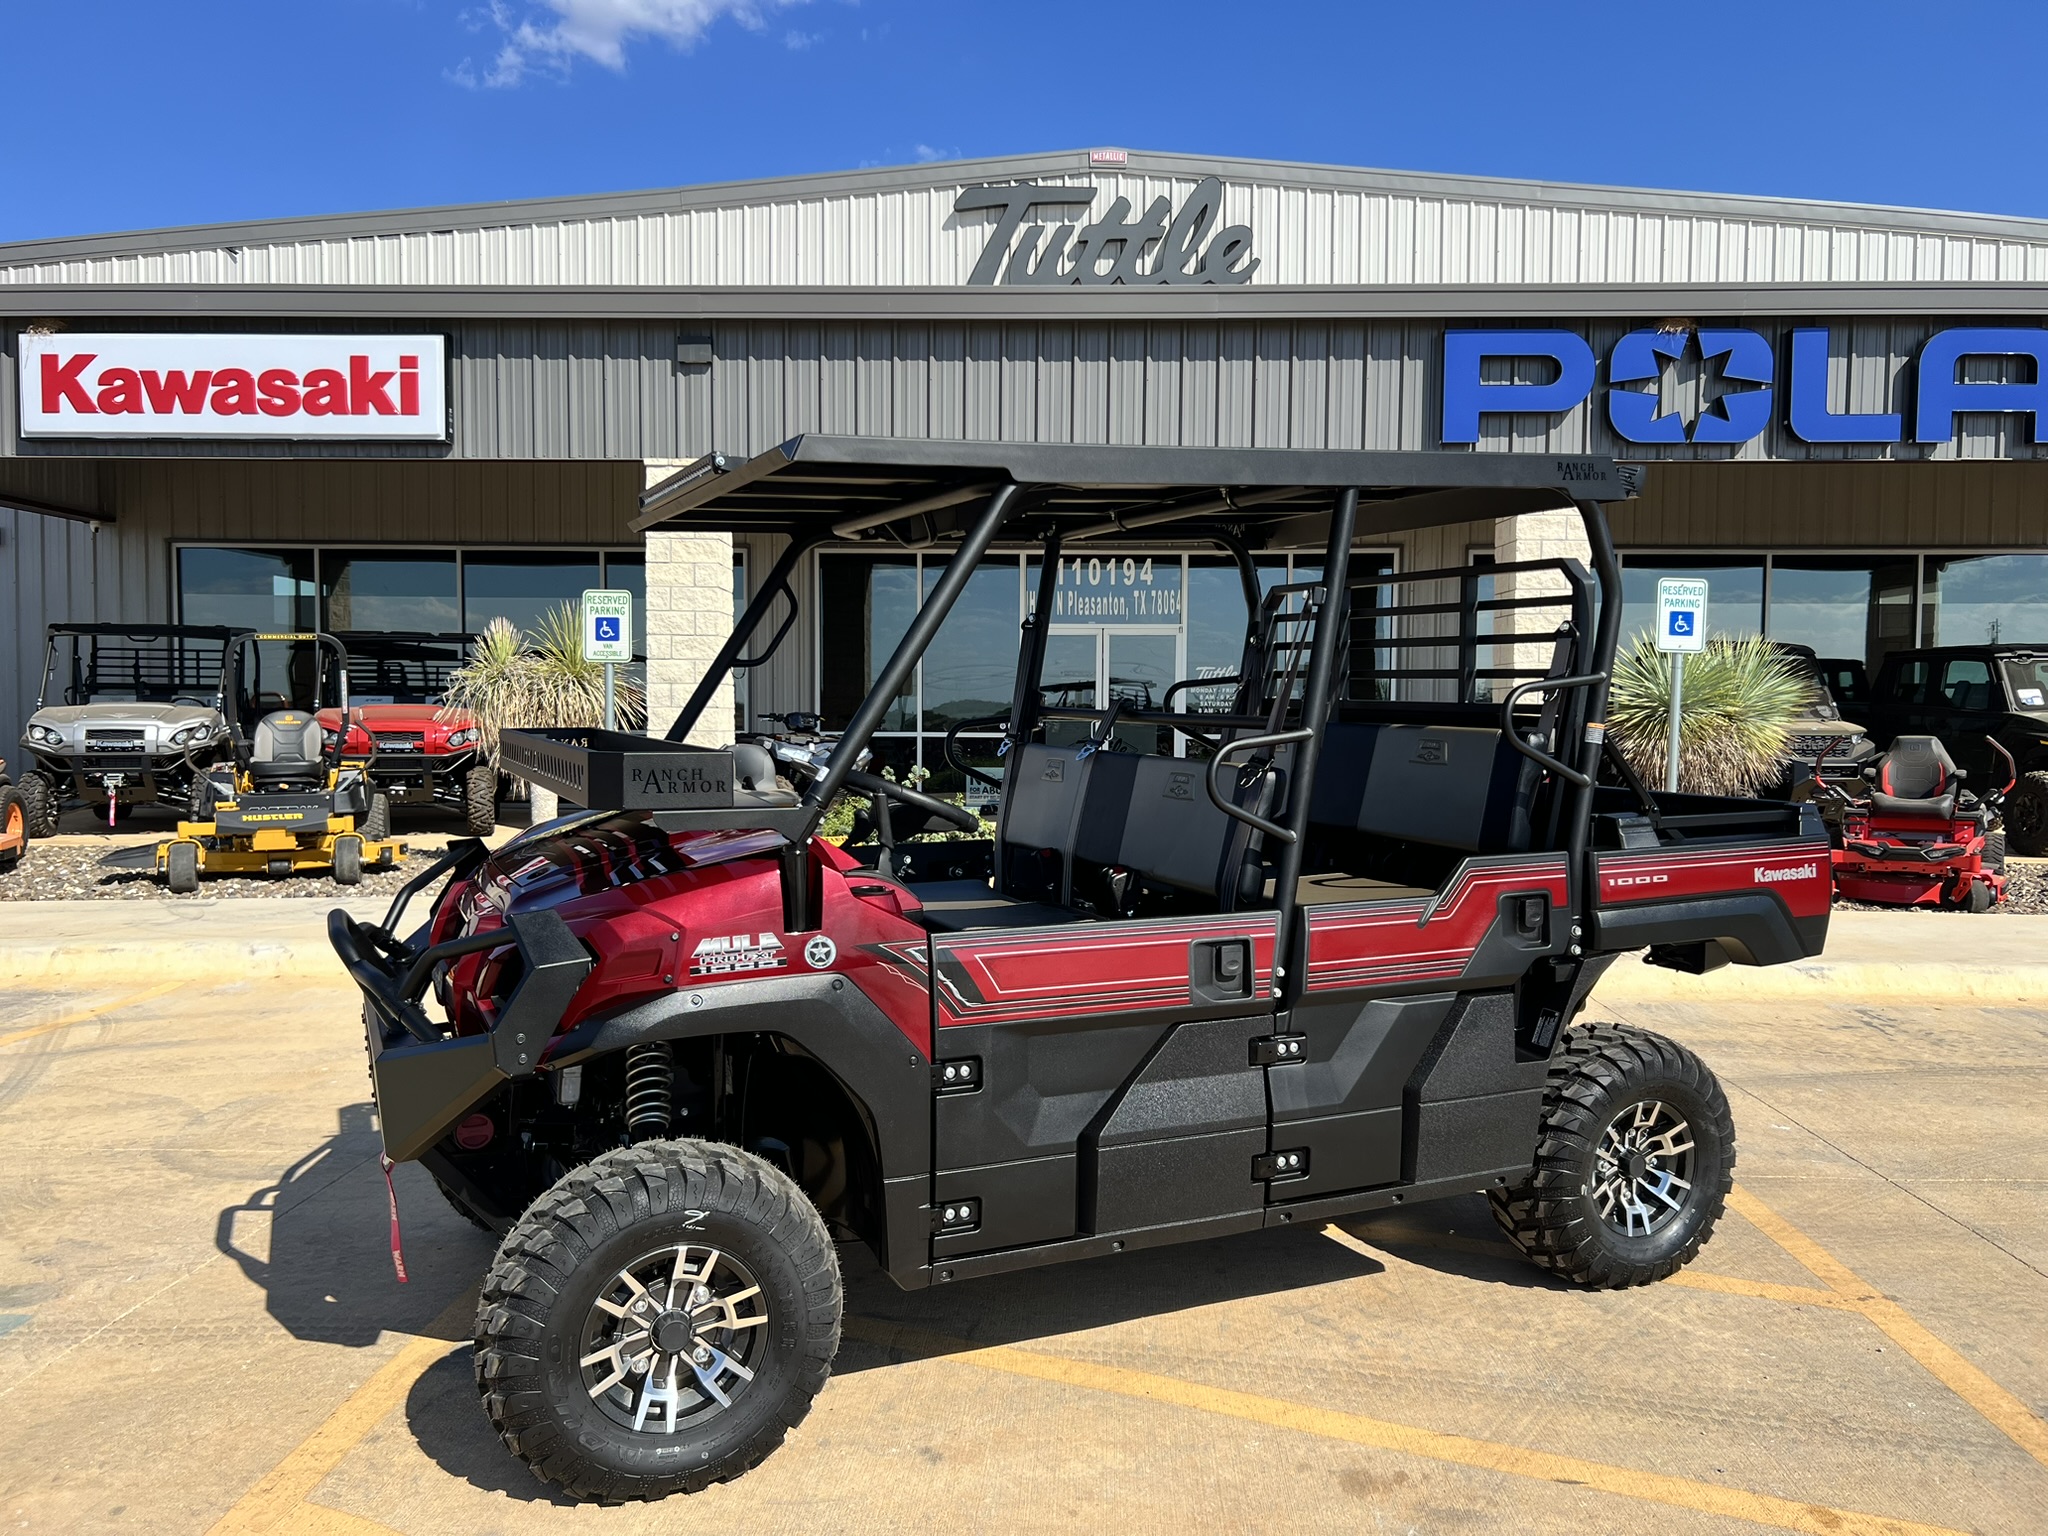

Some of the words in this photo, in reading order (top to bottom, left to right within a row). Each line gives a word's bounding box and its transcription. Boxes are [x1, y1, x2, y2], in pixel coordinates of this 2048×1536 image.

[1092, 151, 1125, 161] METALLIC
[954, 177, 1261, 285] Tuttle
[41, 353, 420, 416] Kawasaki
[1557, 462, 1594, 480] RANCH
[1562, 464, 1607, 480] ARMOR
[1057, 558, 1153, 585] 110194
[1663, 585, 1704, 596] RESERVED
[587, 595, 628, 605] RESERVED
[1068, 590, 1129, 621] Pleasanton,
[1133, 590, 1147, 615] TX
[1151, 589, 1181, 615] 78064
[1664, 598, 1701, 608] PARKING
[590, 606, 625, 615] PARKING
[1196, 665, 1238, 680] Tuttle
[380, 741, 413, 749] Kawasaki
[631, 768, 704, 793] RANCH
[642, 769, 727, 793] ARMOR
[242, 813, 304, 822] HUSTLER
[1608, 875, 1668, 886] 1000
[1754, 863, 1817, 883] Kawasaki
[691, 932, 785, 959] MULE
